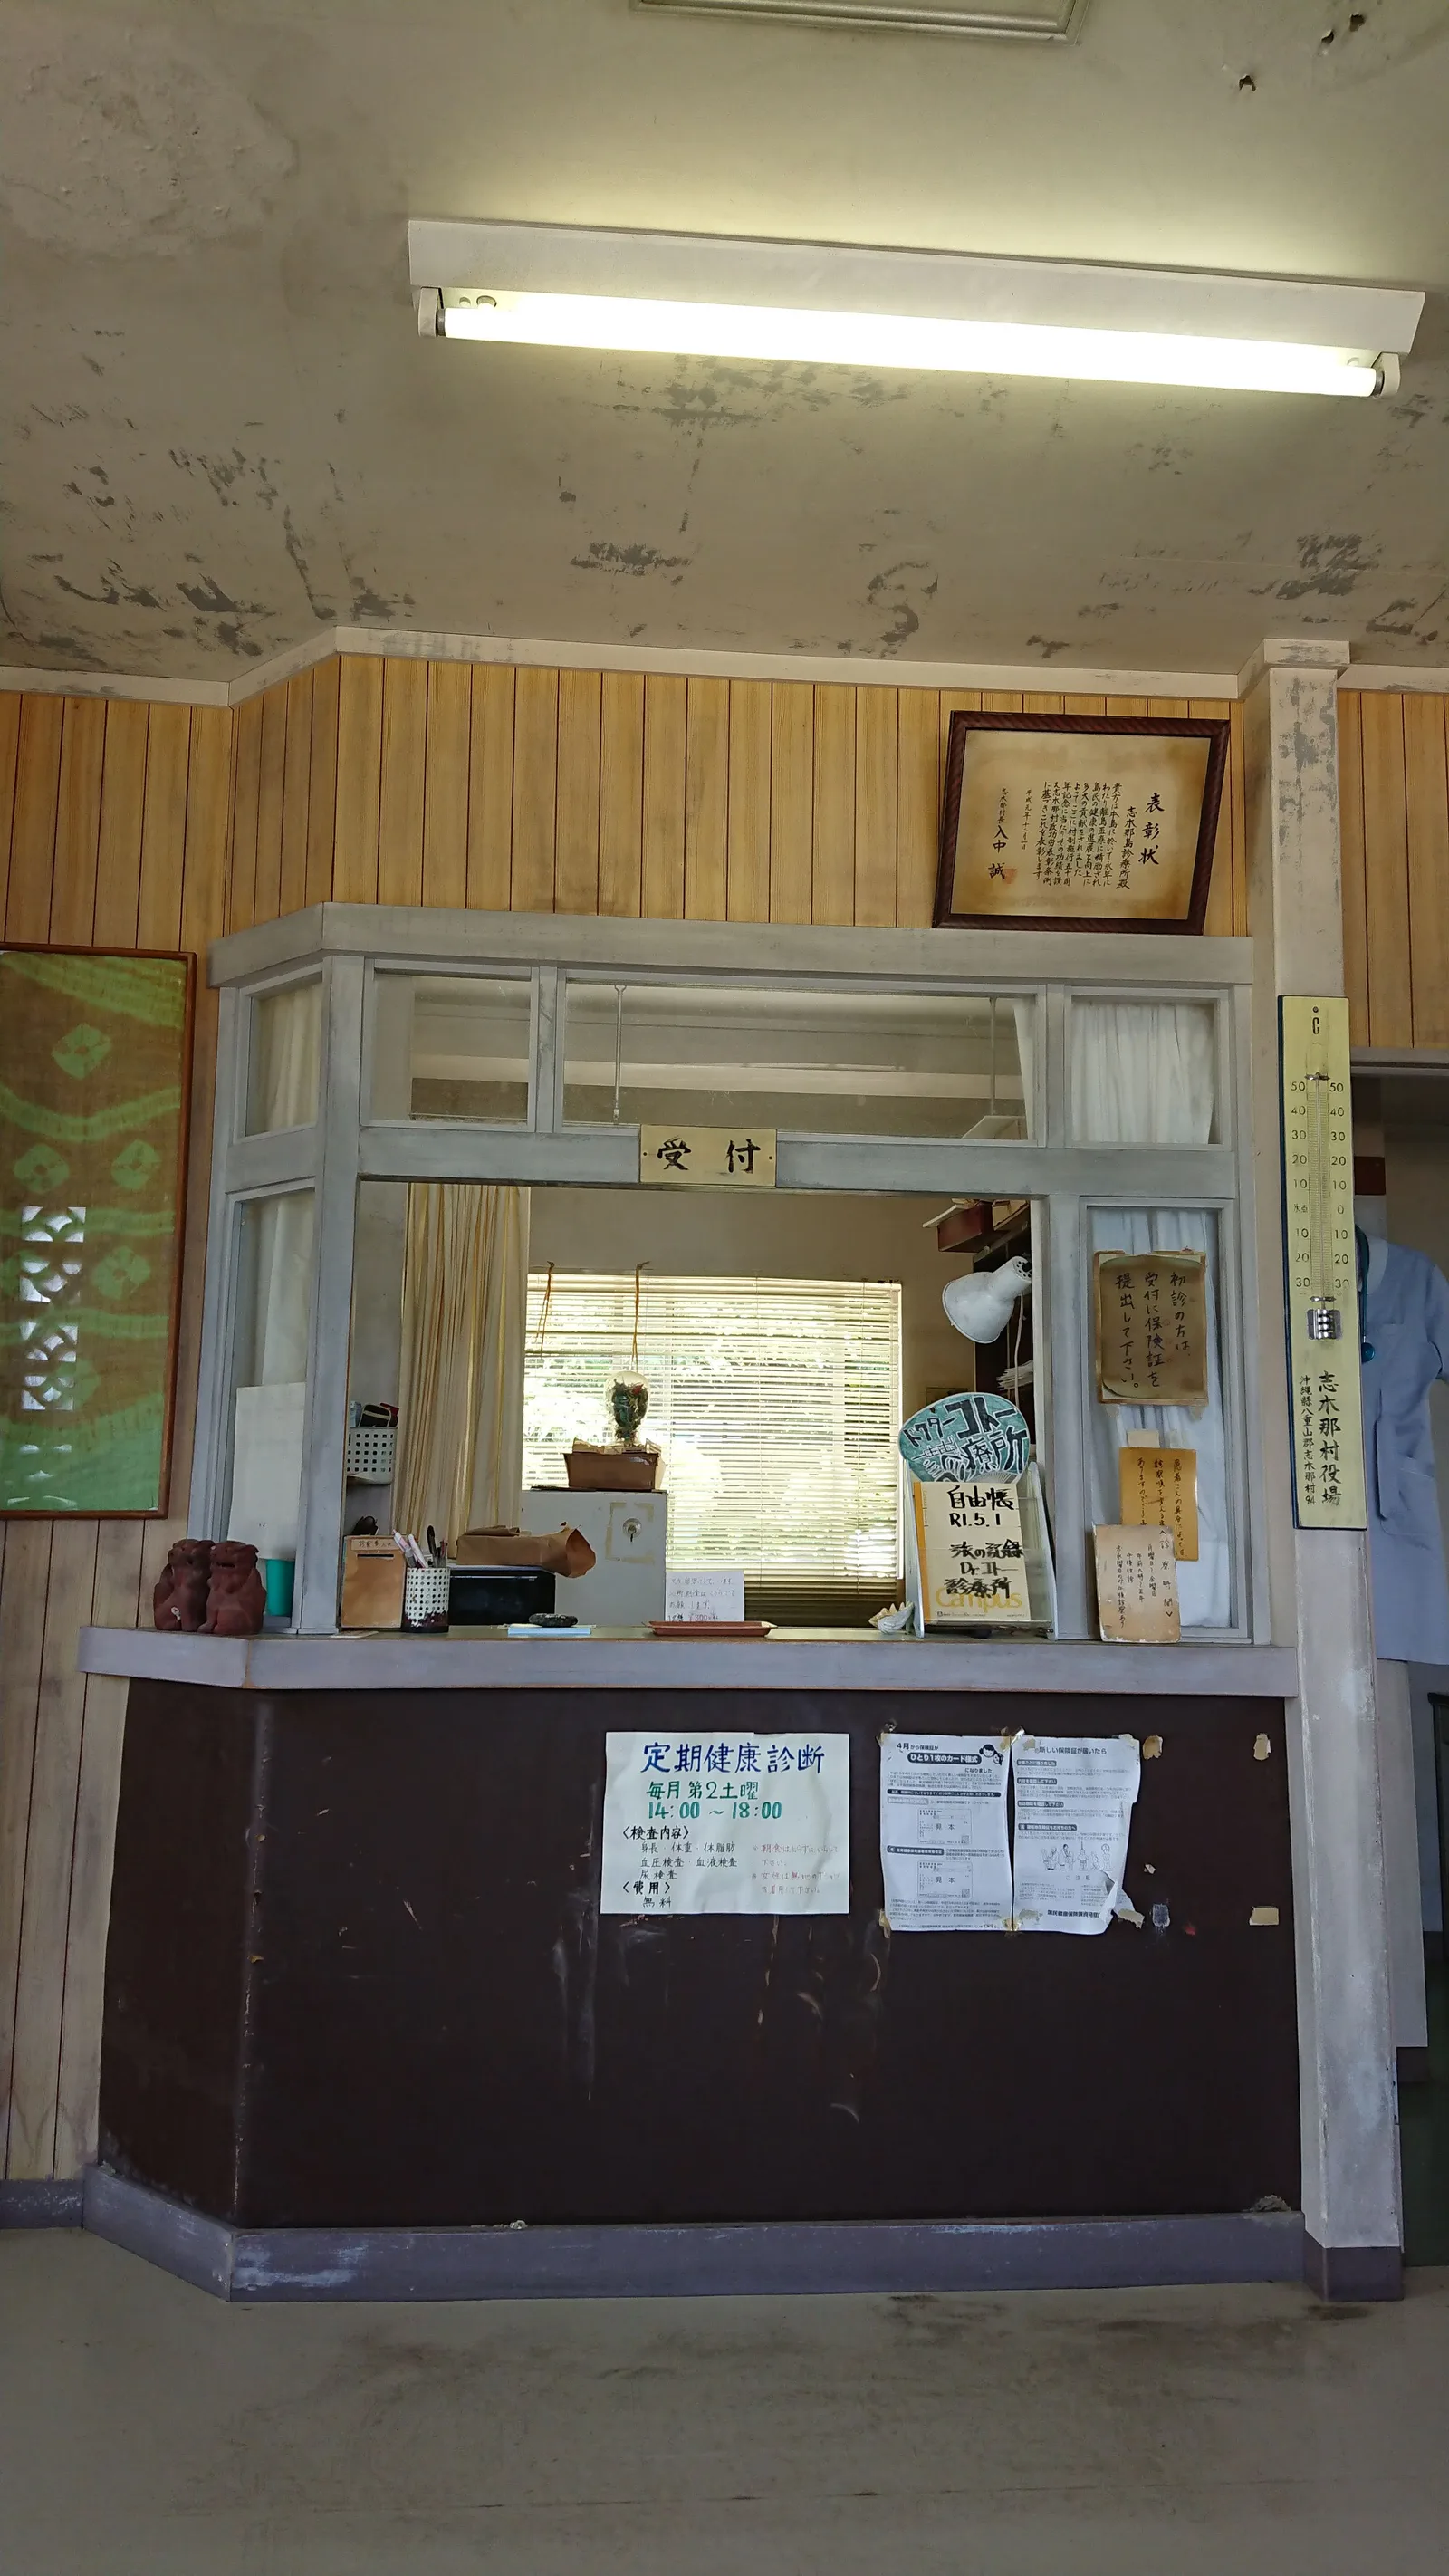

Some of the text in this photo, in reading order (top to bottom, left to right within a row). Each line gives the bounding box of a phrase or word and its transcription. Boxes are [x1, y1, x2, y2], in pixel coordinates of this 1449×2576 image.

[1138, 792, 1166, 866] 表彰状
[1291, 1082, 1306, 1091] 50
[1329, 1083, 1344, 1092] 50
[1291, 1106, 1306, 1115] 40
[1330, 1107, 1345, 1117] 40
[1291, 1130, 1307, 1139] 30
[1330, 1131, 1346, 1141] 30
[657, 1136, 761, 1174] 受付
[1292, 1155, 1307, 1164] 20
[1331, 1156, 1347, 1166] 20
[1293, 1179, 1308, 1189] 10
[1332, 1180, 1347, 1190] 10
[1337, 1205, 1345, 1215] 0
[1296, 1227, 1309, 1238] 10
[1335, 1229, 1348, 1239] 10
[1295, 1253, 1310, 1262] 20
[1334, 1254, 1348, 1264] 20
[1295, 1277, 1310, 1287] 30
[1144, 1272, 1166, 1388] 受付に保険証を
[1318, 1370, 1342, 1506] 志木那村役場
[946, 1485, 1015, 1511] 自由帳
[640, 1741, 825, 1774] 定期健康診断
[639, 1869, 677, 1880] 尿検査
[642, 1896, 672, 1908] 無料
